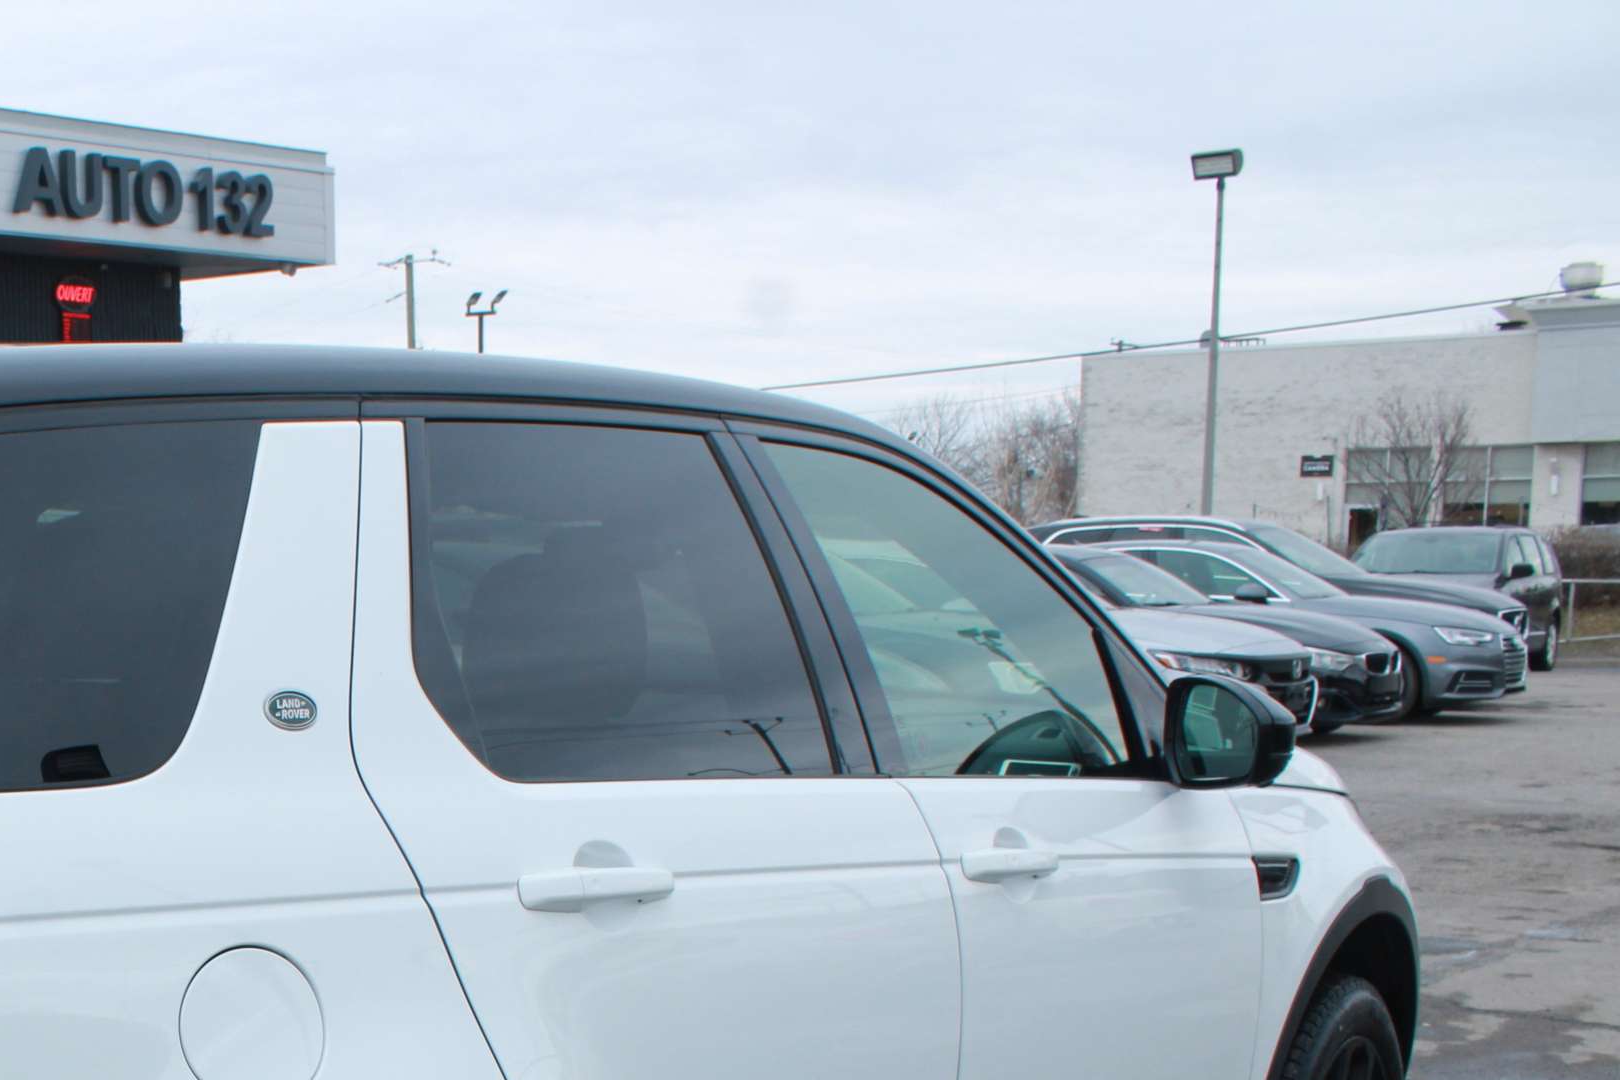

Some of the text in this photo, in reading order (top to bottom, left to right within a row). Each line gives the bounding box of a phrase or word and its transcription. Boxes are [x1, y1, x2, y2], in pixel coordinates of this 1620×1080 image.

[13, 146, 182, 226] AUTO
[190, 166, 275, 238] 132
[56, 284, 95, 303] OUVERT
[276, 698, 301, 710] LAND
[281, 708, 311, 720] ROVER
